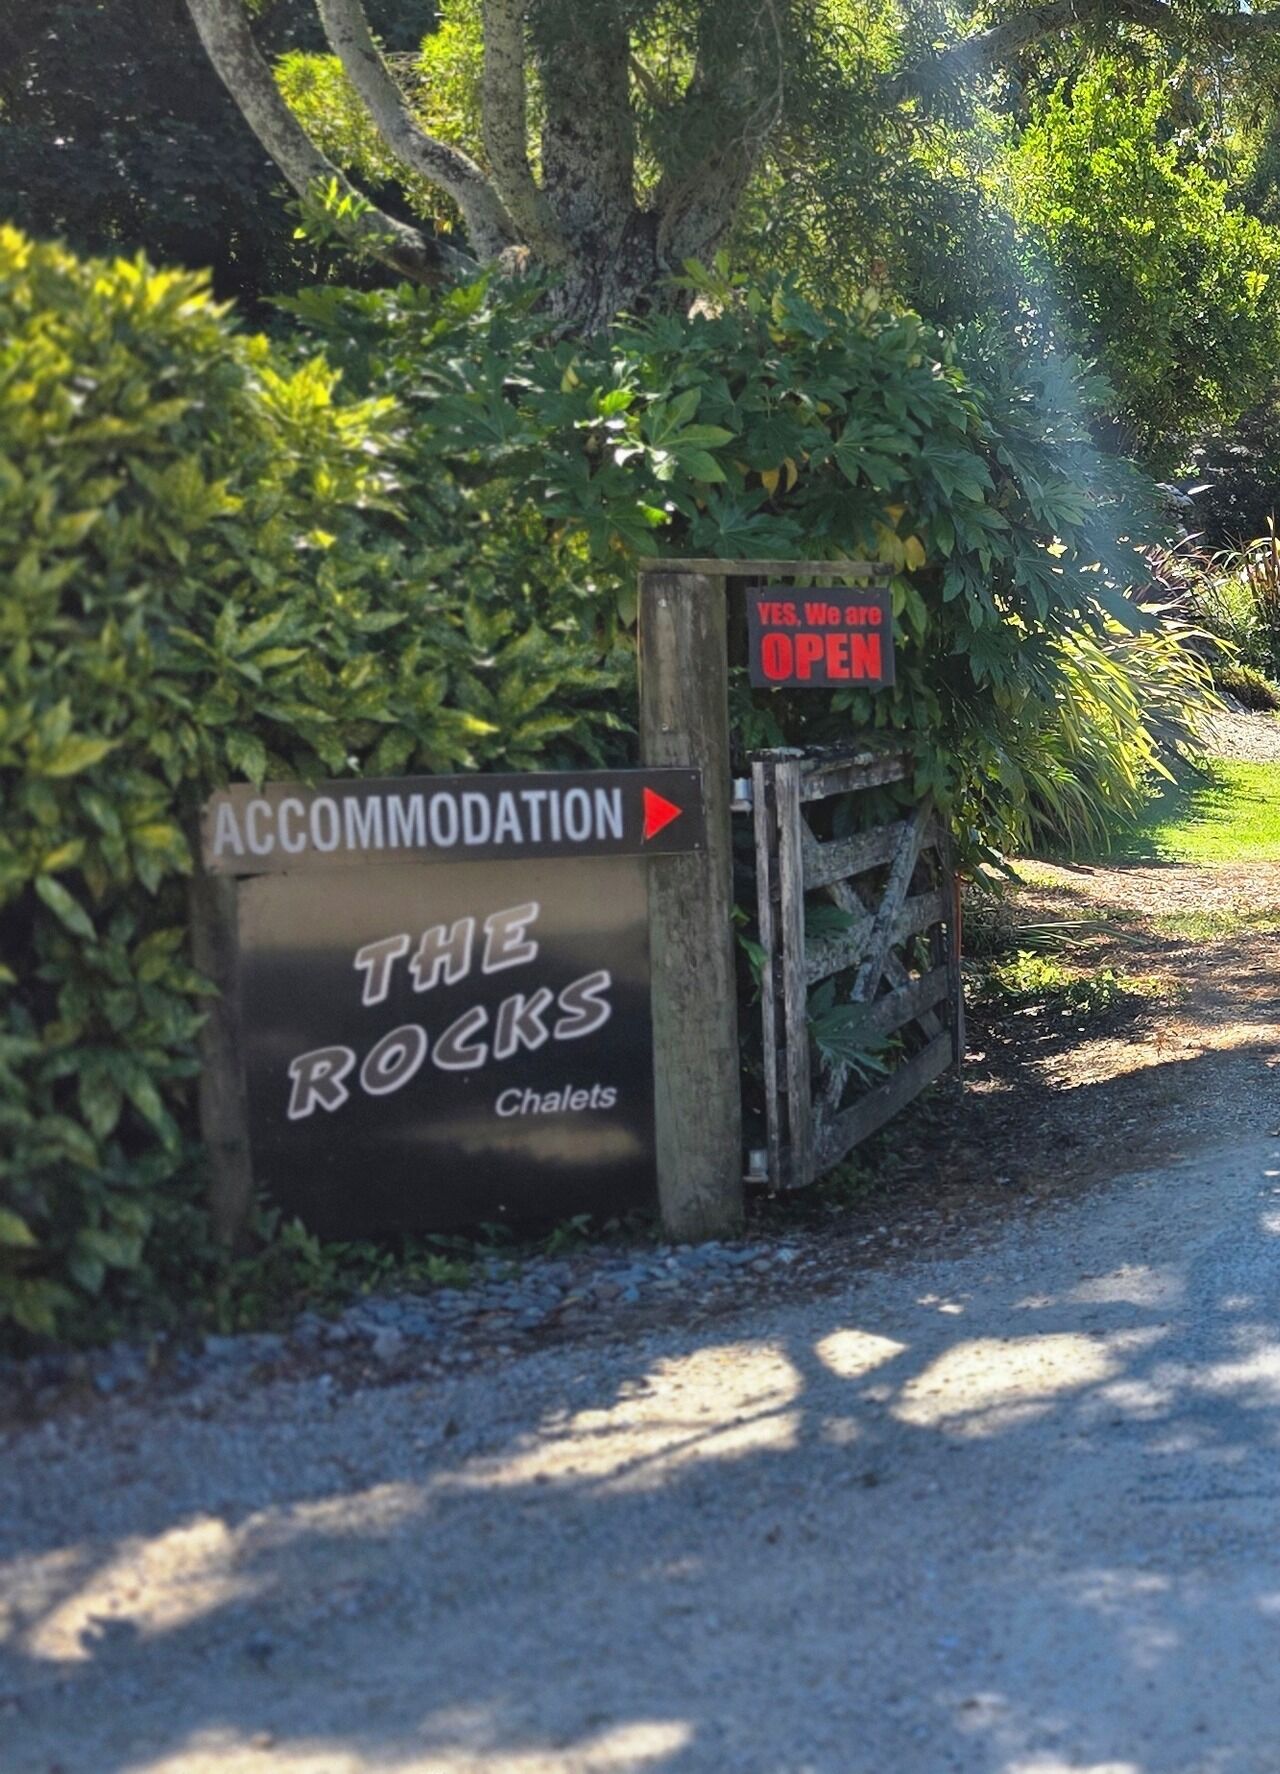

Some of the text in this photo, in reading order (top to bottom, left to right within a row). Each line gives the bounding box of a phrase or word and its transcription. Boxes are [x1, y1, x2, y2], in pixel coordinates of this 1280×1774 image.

[804, 602, 840, 625] We
[845, 606, 882, 625] are
[762, 632, 882, 680] OPEN
[213, 788, 624, 856] ACCOMMODATION
[353, 902, 540, 1006] THE
[286, 970, 613, 1120] ROCKS
[493, 1083, 617, 1118] Chalets
